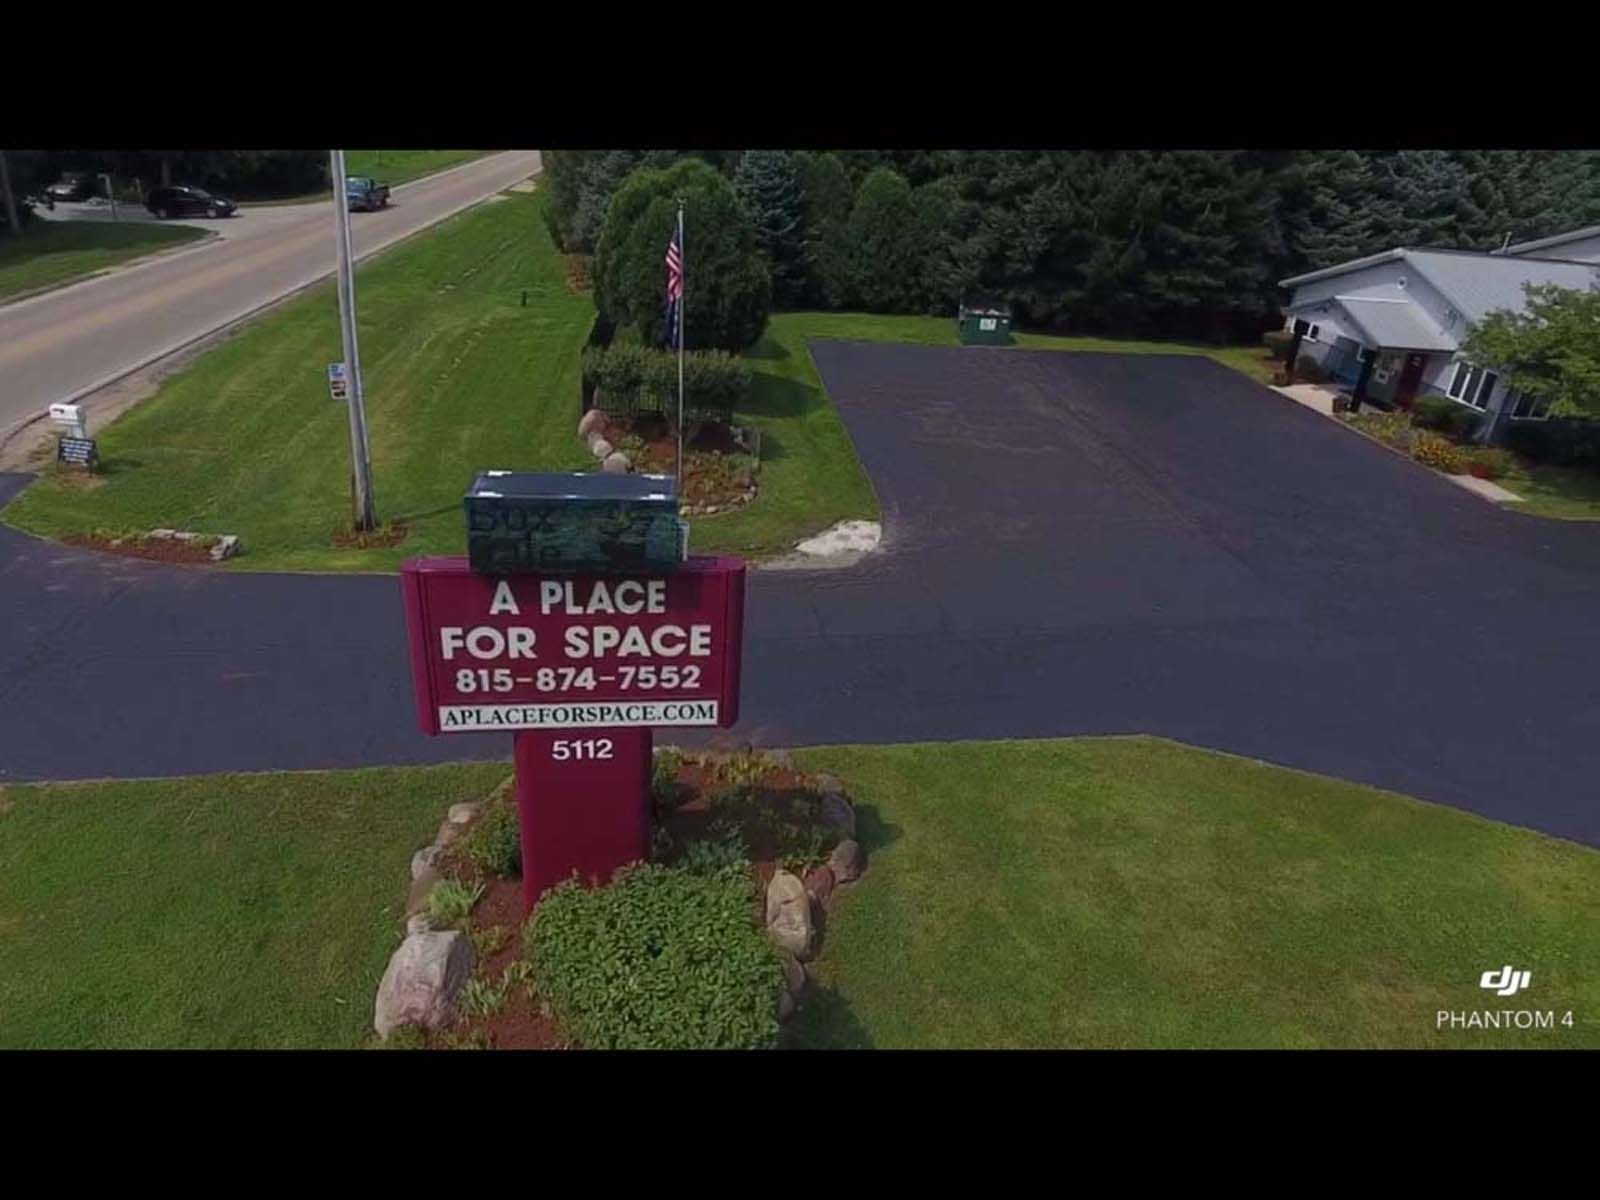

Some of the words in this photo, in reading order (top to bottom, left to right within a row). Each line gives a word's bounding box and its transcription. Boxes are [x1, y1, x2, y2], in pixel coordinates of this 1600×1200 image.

[489, 581, 520, 615] A
[541, 580, 666, 615] PLACE
[440, 626, 537, 660] FOR
[564, 624, 712, 659] SPACE
[456, 665, 701, 693] 815-874-7552
[444, 702, 716, 727] APLACEFORSPACE.COM
[551, 739, 613, 761] 5112
